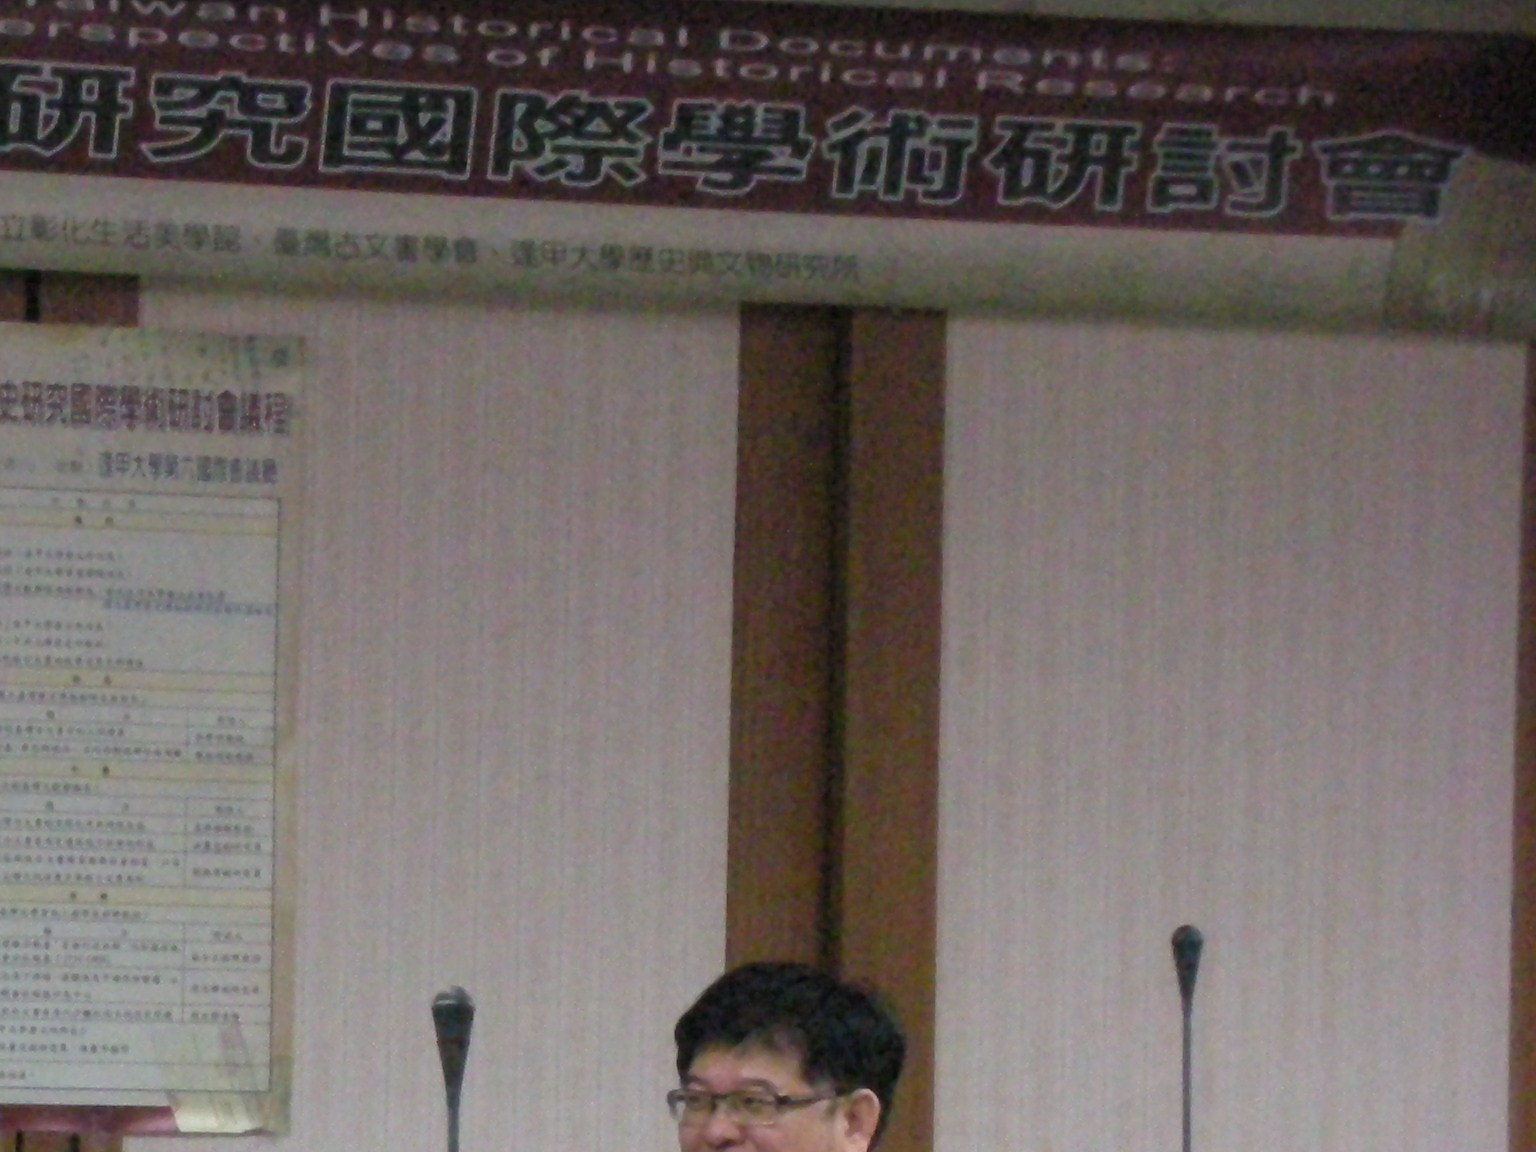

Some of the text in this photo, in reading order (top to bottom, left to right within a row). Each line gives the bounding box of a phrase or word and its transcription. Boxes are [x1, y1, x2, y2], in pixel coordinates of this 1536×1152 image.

[319, 4, 689, 47] Historical
[486, 47, 557, 68] of
[583, 50, 946, 89] Historical
[977, 69, 1337, 107] Research
